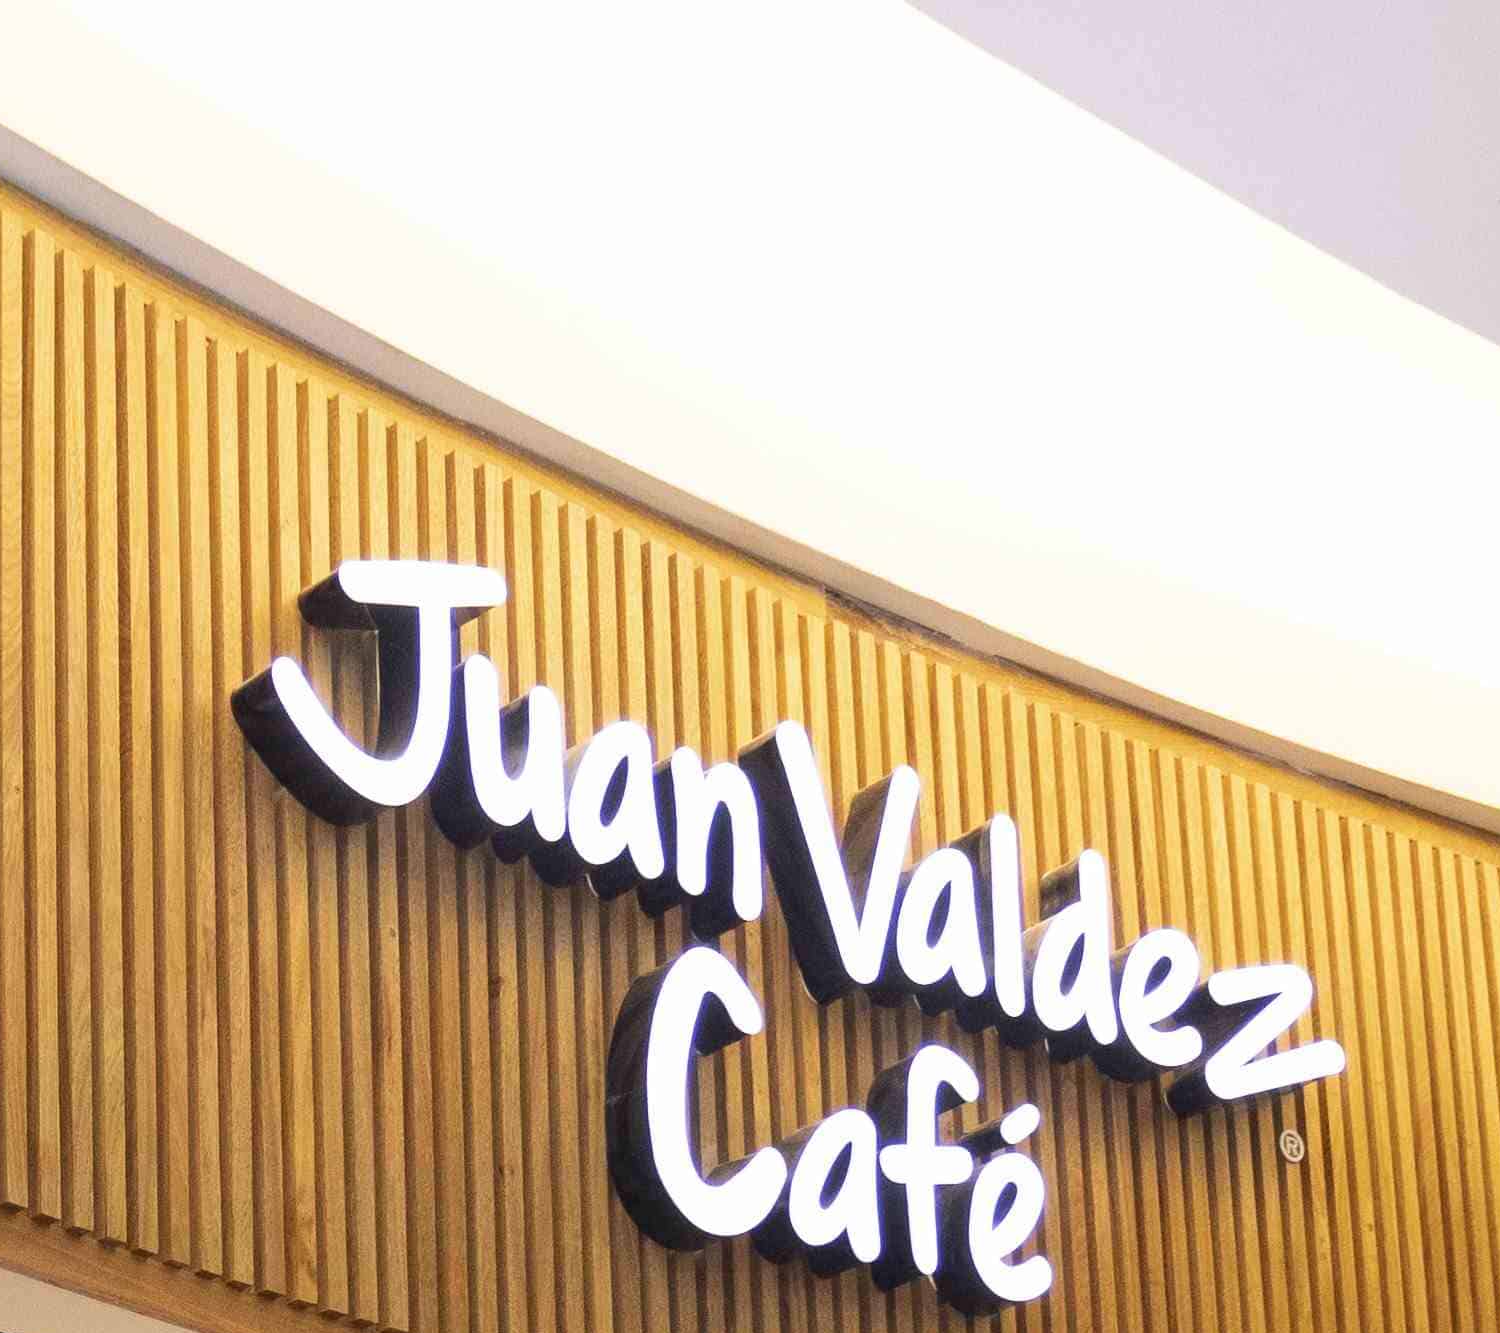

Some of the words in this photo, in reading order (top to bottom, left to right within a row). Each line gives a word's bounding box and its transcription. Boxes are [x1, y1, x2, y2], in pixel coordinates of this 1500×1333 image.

[271, 559, 763, 921] Juan
[774, 720, 1346, 1101] Valdez
[646, 945, 1054, 1302] Café
